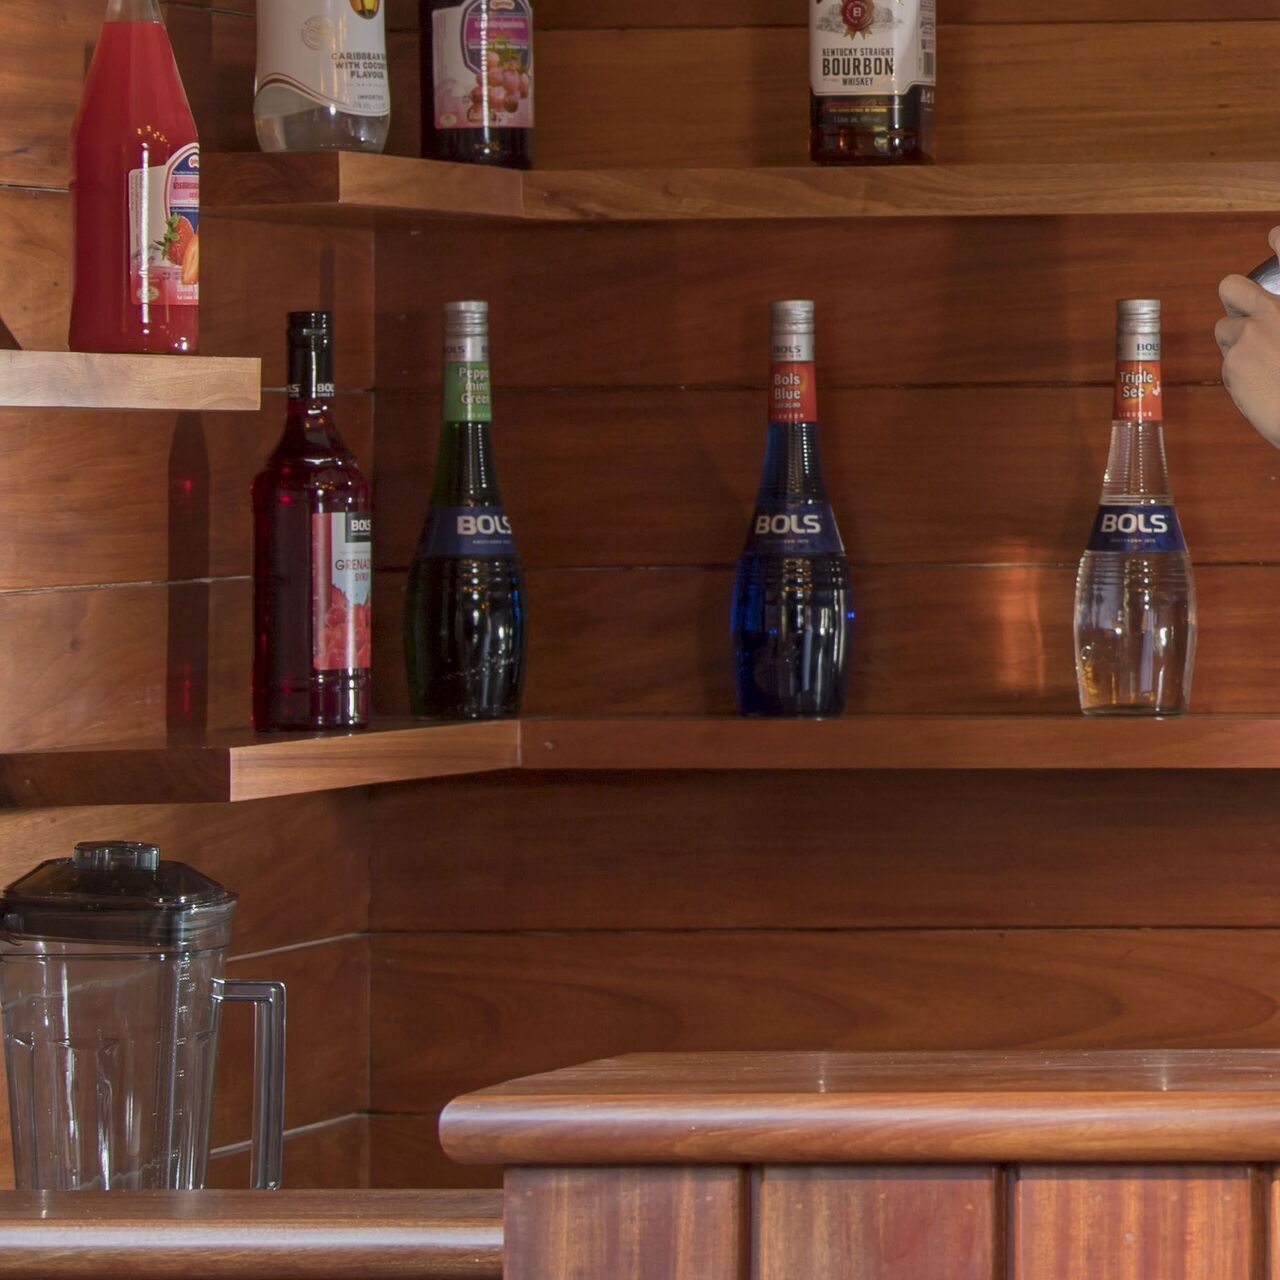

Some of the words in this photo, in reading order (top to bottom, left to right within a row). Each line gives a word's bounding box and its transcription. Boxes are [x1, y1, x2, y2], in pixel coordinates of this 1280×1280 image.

[822, 48, 858, 56] KENTUCKY
[860, 47, 894, 56] STRAIGHT
[822, 57, 894, 76] BOURBON
[842, 77, 873, 86] WHISKEY
[774, 373, 800, 385] Bols
[1119, 371, 1153, 386] Triple
[774, 387, 800, 400] Blue
[1123, 386, 1145, 398] Sec
[755, 515, 821, 534] BOLS
[1101, 513, 1168, 534] BOLS
